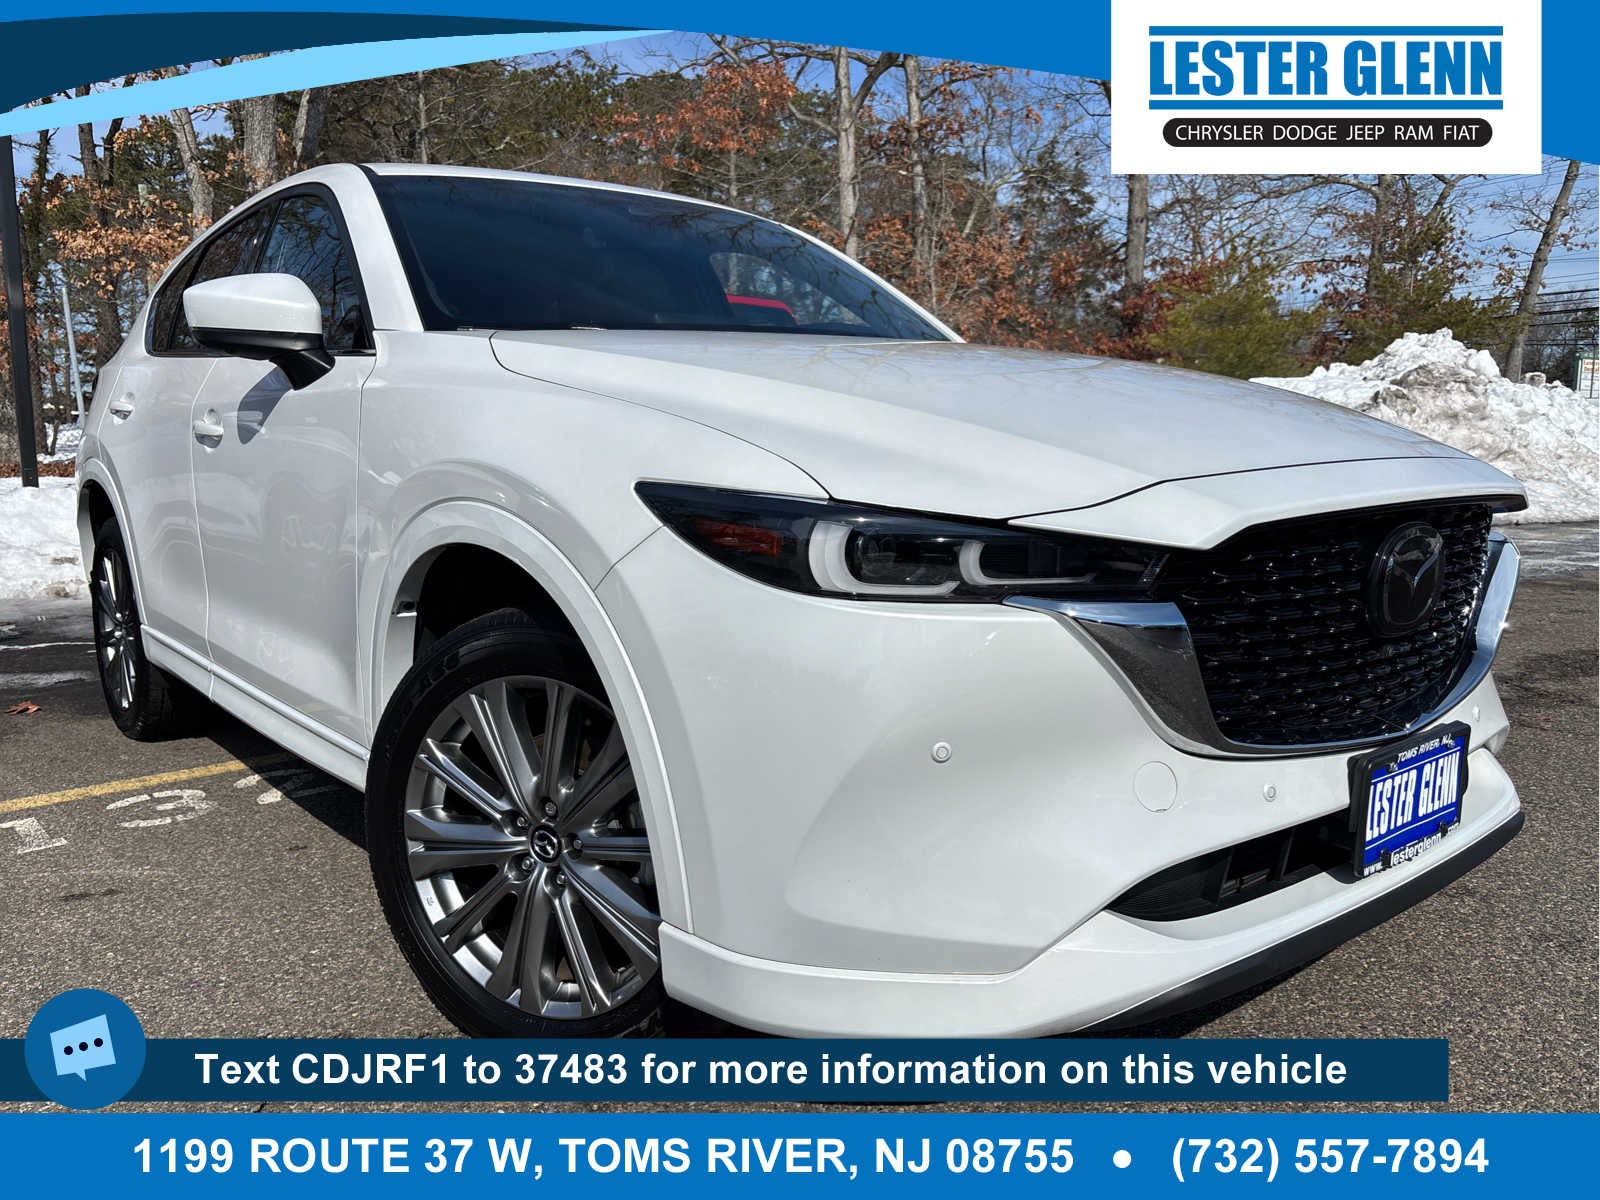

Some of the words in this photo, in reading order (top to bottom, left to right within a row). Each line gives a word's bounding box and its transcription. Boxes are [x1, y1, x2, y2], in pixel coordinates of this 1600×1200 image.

[1397, 746, 1419, 763] TOMS
[1365, 769, 1417, 842] LESTER
[1417, 751, 1460, 818] GLENN
